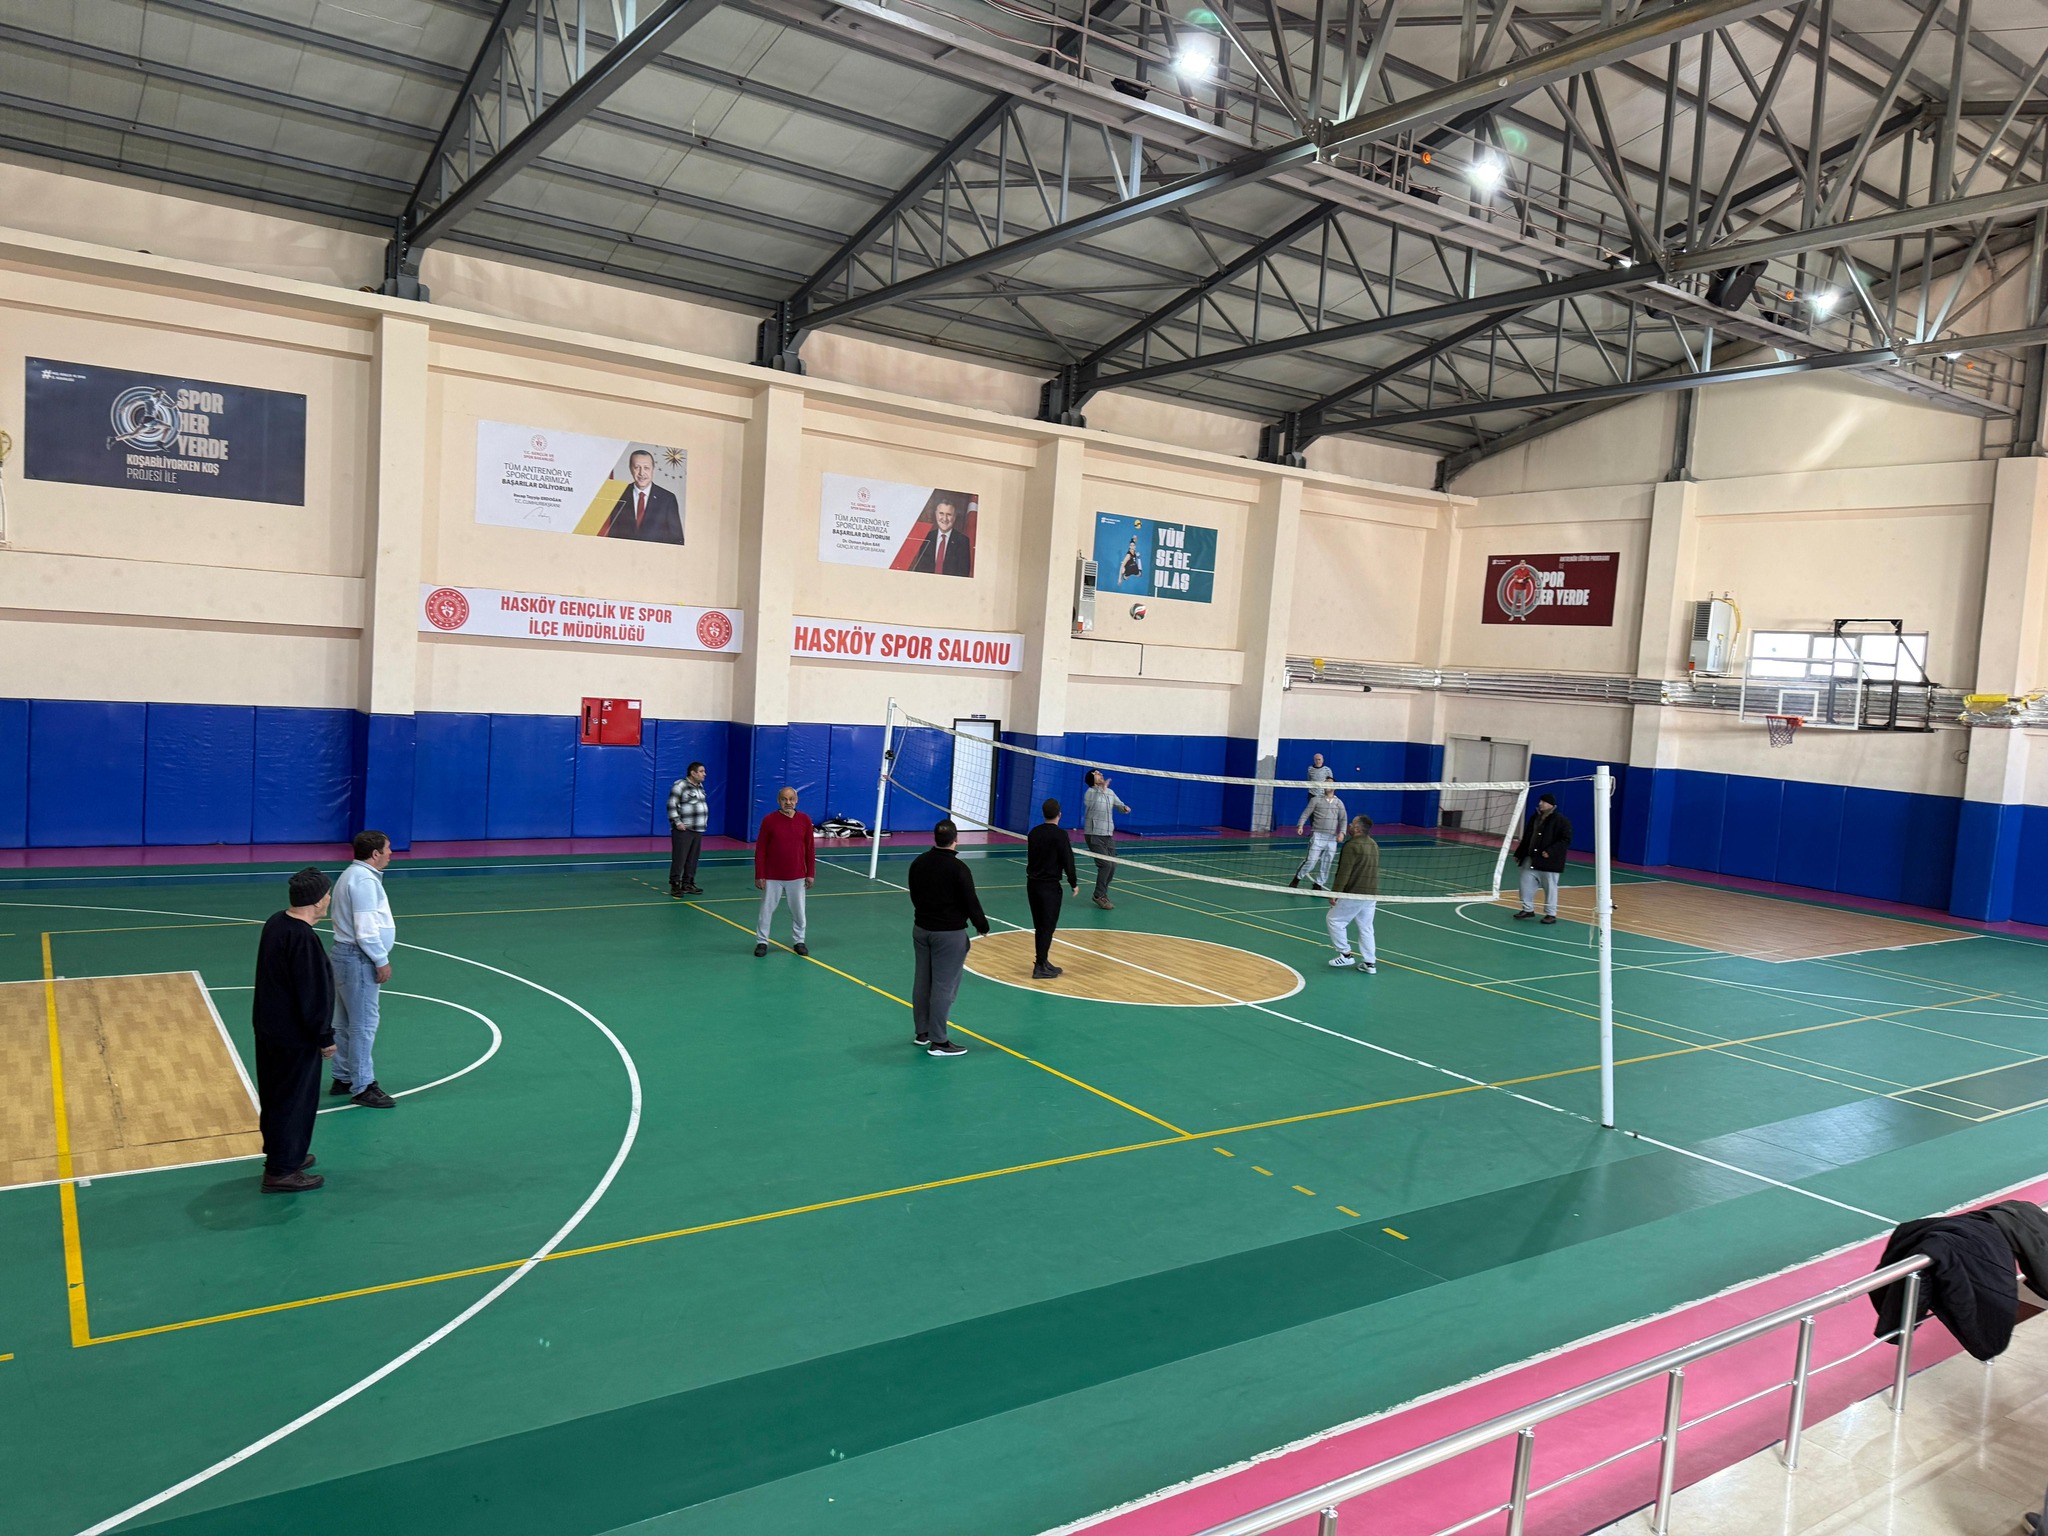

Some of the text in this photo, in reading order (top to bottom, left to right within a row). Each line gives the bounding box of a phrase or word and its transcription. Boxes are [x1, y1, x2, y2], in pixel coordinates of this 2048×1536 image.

[177, 388, 224, 414] SPOR
[179, 412, 209, 435] HER
[177, 435, 229, 460] YERDE
[126, 453, 220, 476] KOŞABİLİYORKEN KOŞ
[126, 467, 177, 484] PROJESİ İLE
[504, 462, 572, 478] TÜM ANTRENÖR VE
[501, 478, 574, 492] BAŞARILAR DİLİYORUM
[506, 470, 570, 485] SPORCULARIMIZA
[835, 513, 849, 522] TÜM
[849, 516, 882, 526] ANTRENÖR
[836, 521, 888, 534] SPORCULARIMIZA
[832, 529, 891, 541] BAŞARILAR DİLİYORUM
[1157, 527, 1185, 549] YÜK
[1155, 548, 1191, 571] SEĞE
[1154, 569, 1190, 593] ULAŞ
[1556, 589, 1590, 606] YERDE
[500, 594, 673, 624] HASKÖY GENÇLİK VE SPOR
[528, 617, 646, 642] İLÇE MÜDÜRLÜĞÜ
[794, 625, 1011, 666] HASKÖY SPOR SALONU
